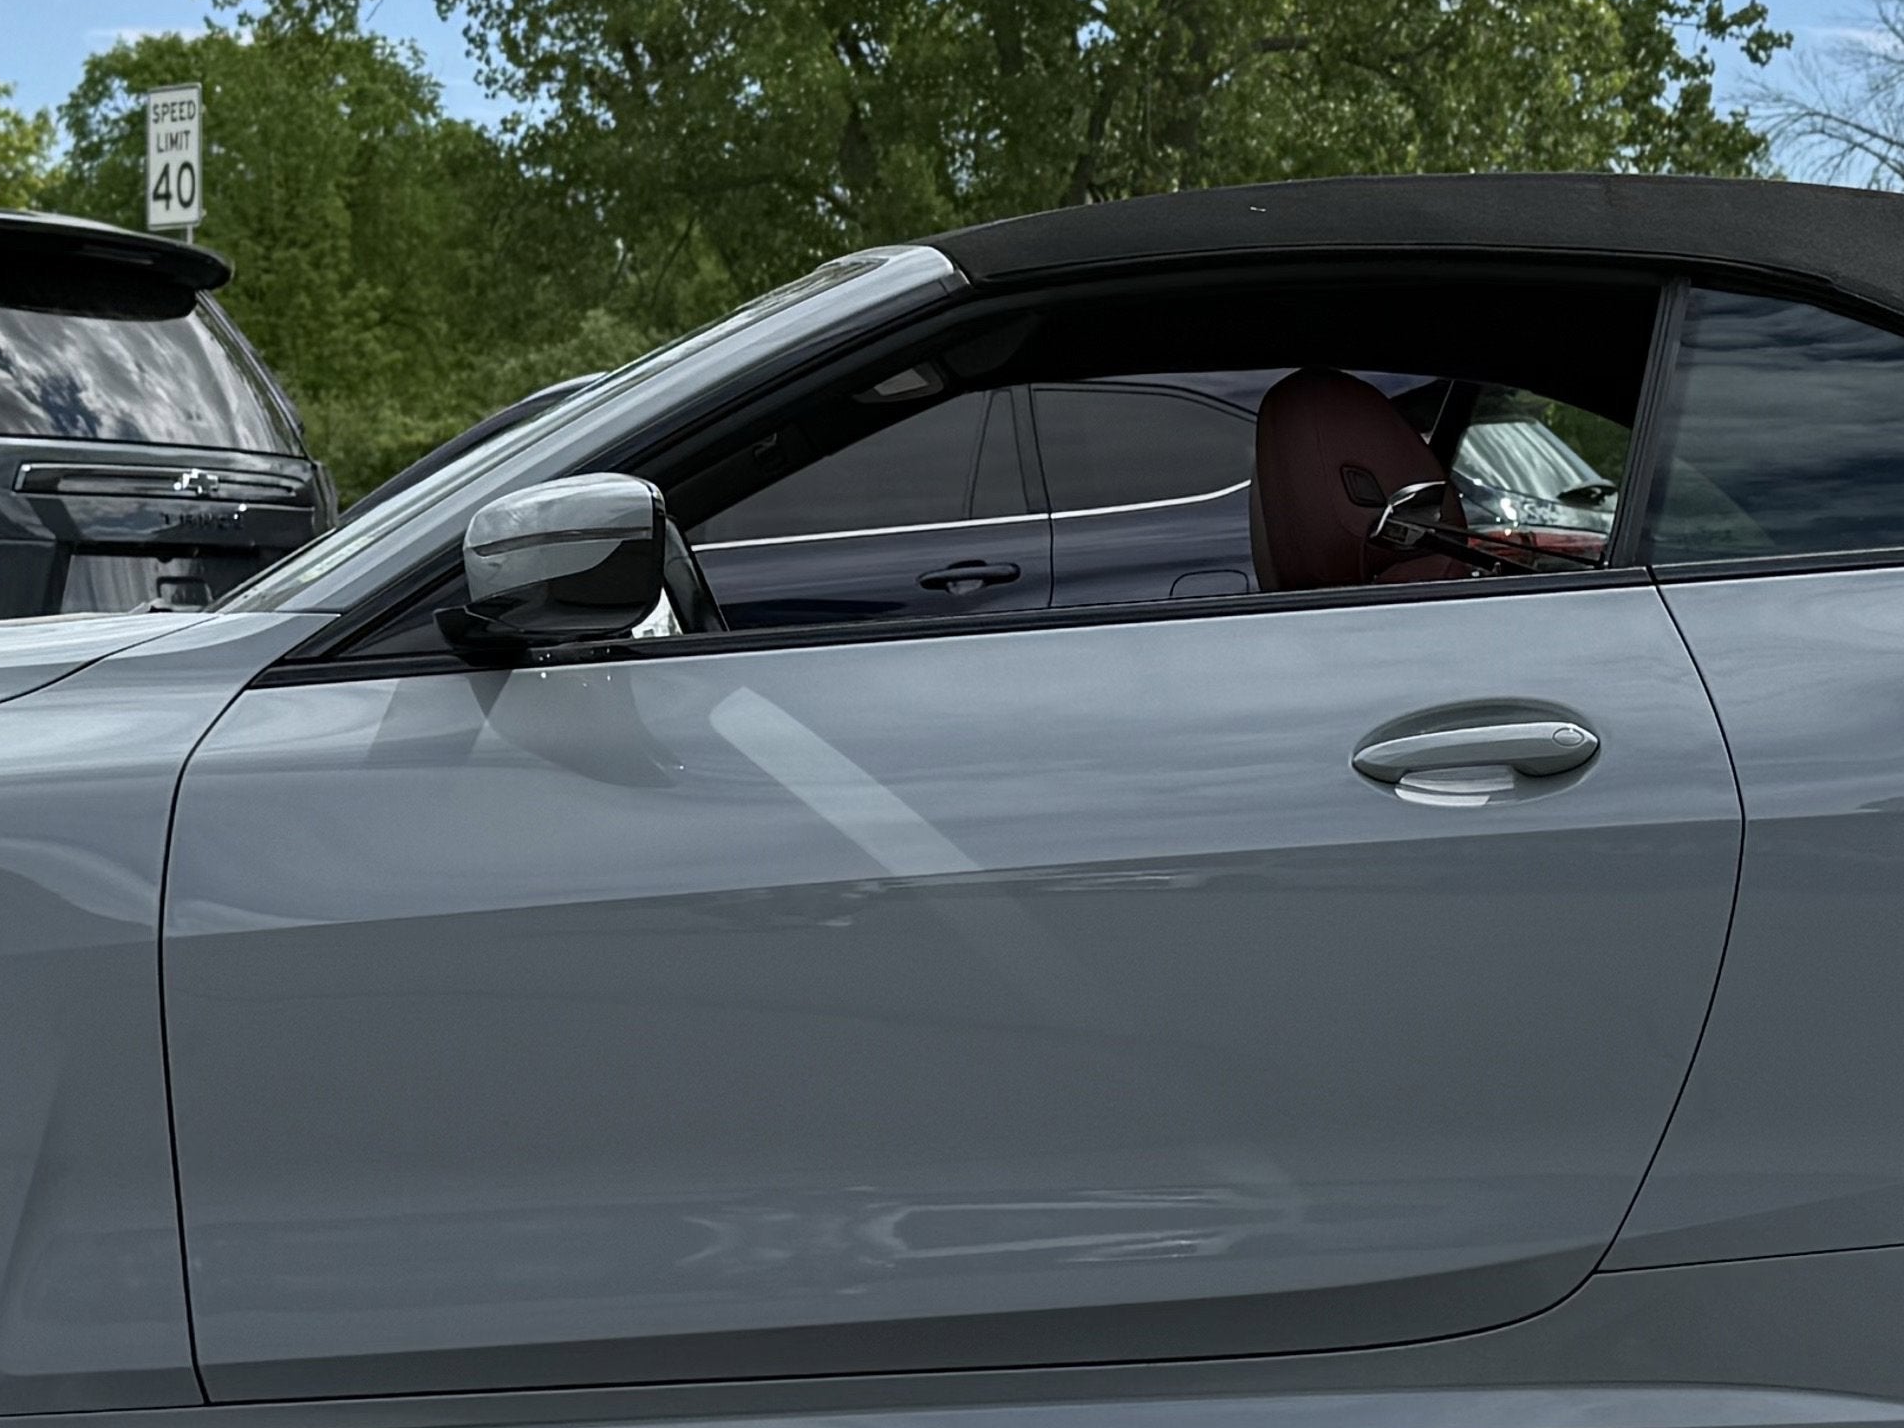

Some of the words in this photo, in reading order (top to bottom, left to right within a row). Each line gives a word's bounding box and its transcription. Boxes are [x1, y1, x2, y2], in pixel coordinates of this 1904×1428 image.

[152, 99, 196, 124] SPEED
[156, 130, 191, 154] LIMIT
[152, 160, 196, 211] 40
